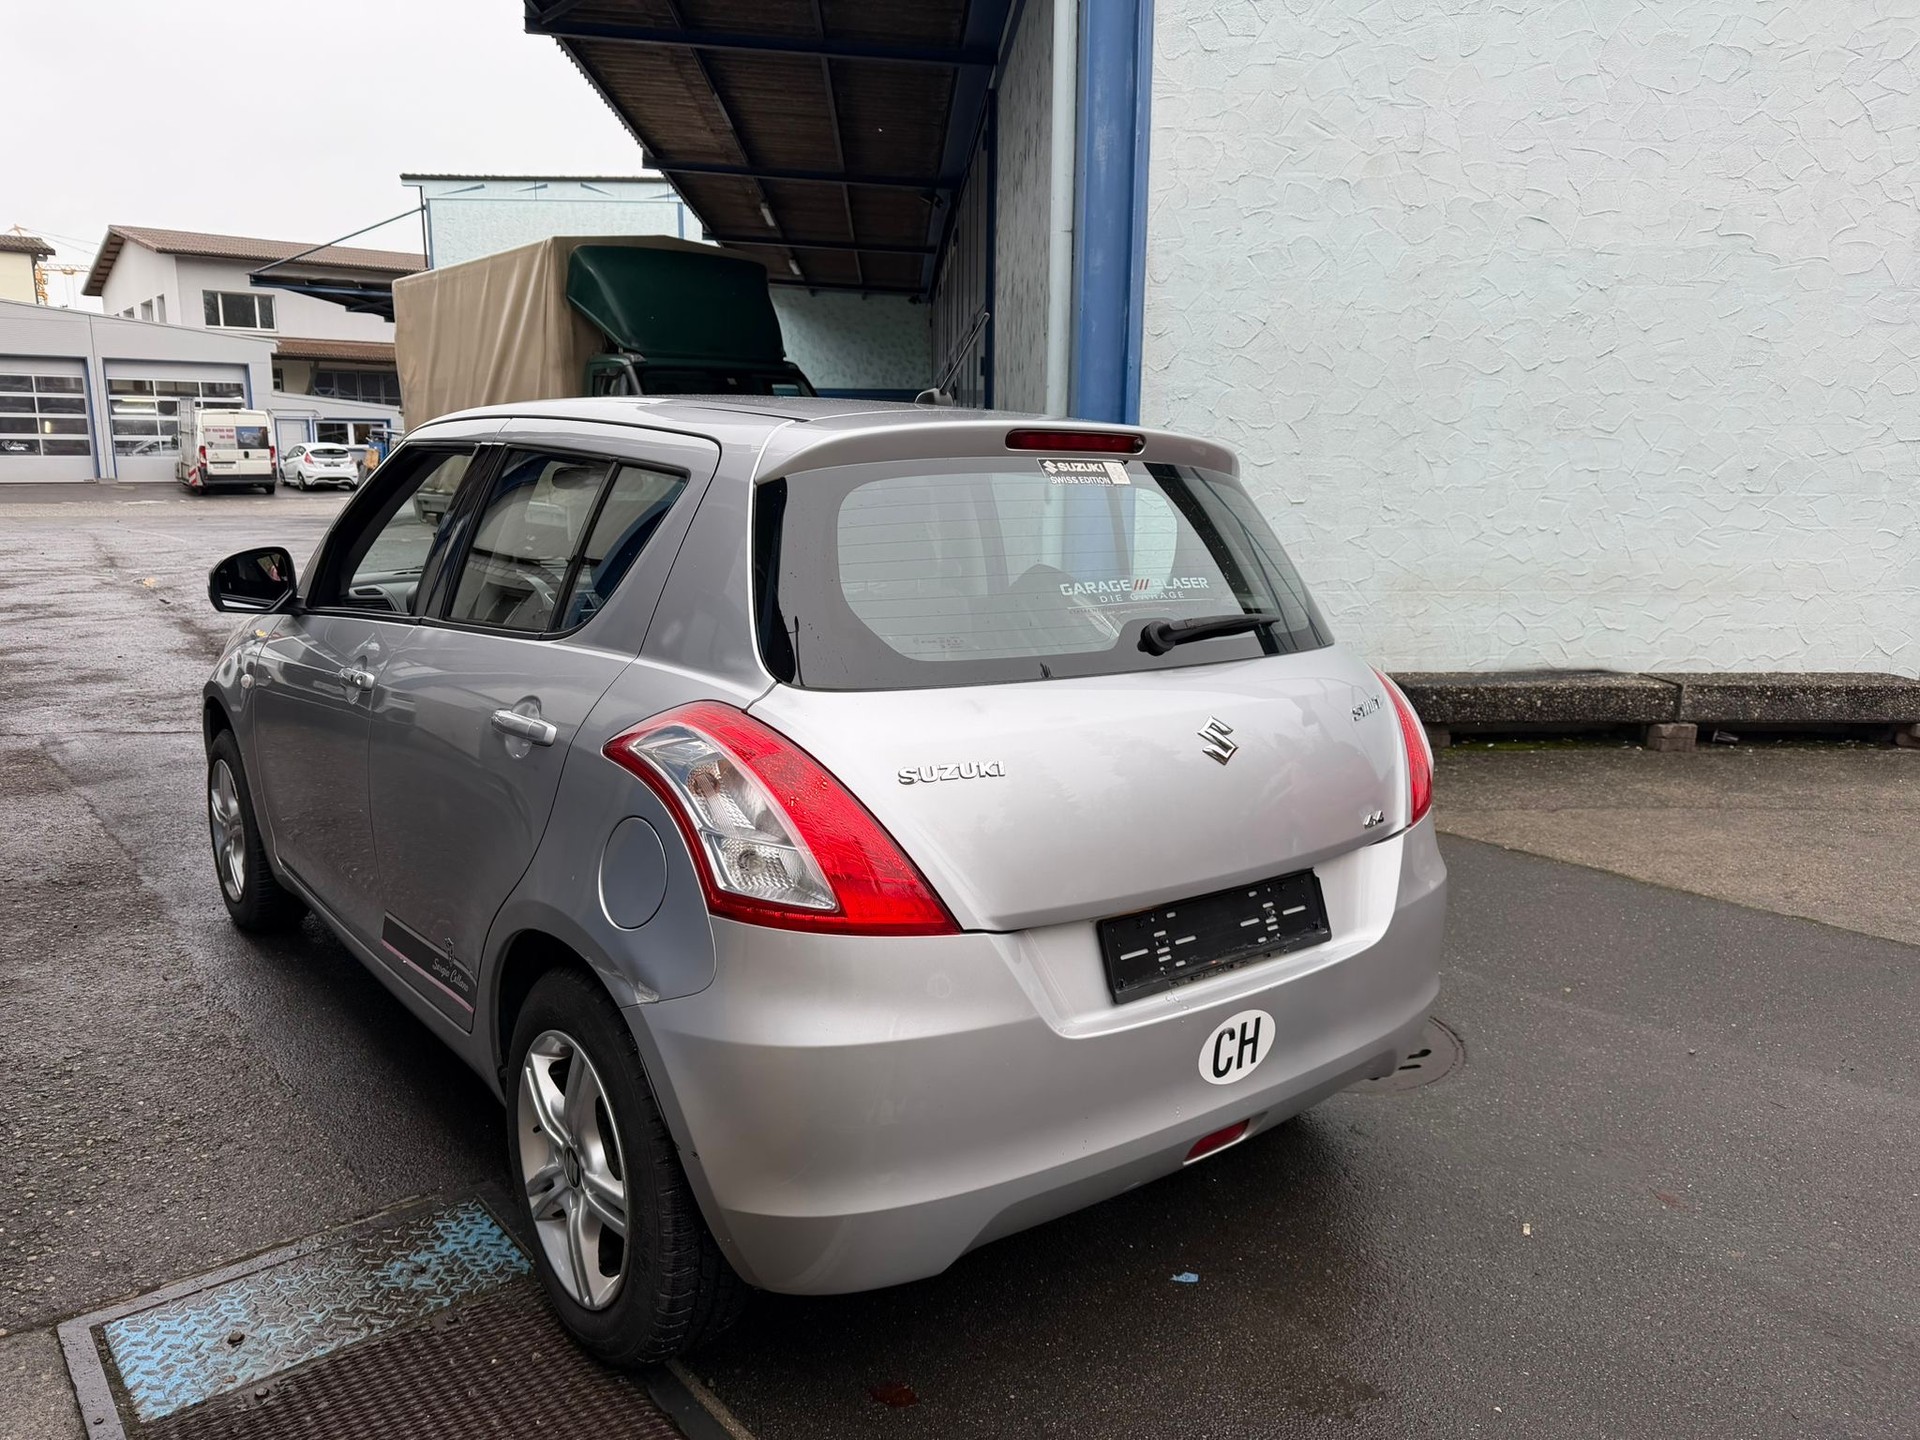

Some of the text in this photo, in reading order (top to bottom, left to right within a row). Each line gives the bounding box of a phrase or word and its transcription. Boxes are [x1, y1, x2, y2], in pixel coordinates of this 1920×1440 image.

[1056, 462, 1105, 472] SUZUKI
[1050, 476, 1112, 485] SWISS EDITION
[1059, 577, 1210, 596] GARAGE BLASER
[1100, 590, 1185, 603] DIE GARAGE
[897, 760, 1006, 785] SUZUKI
[1213, 1016, 1261, 1078] CH
